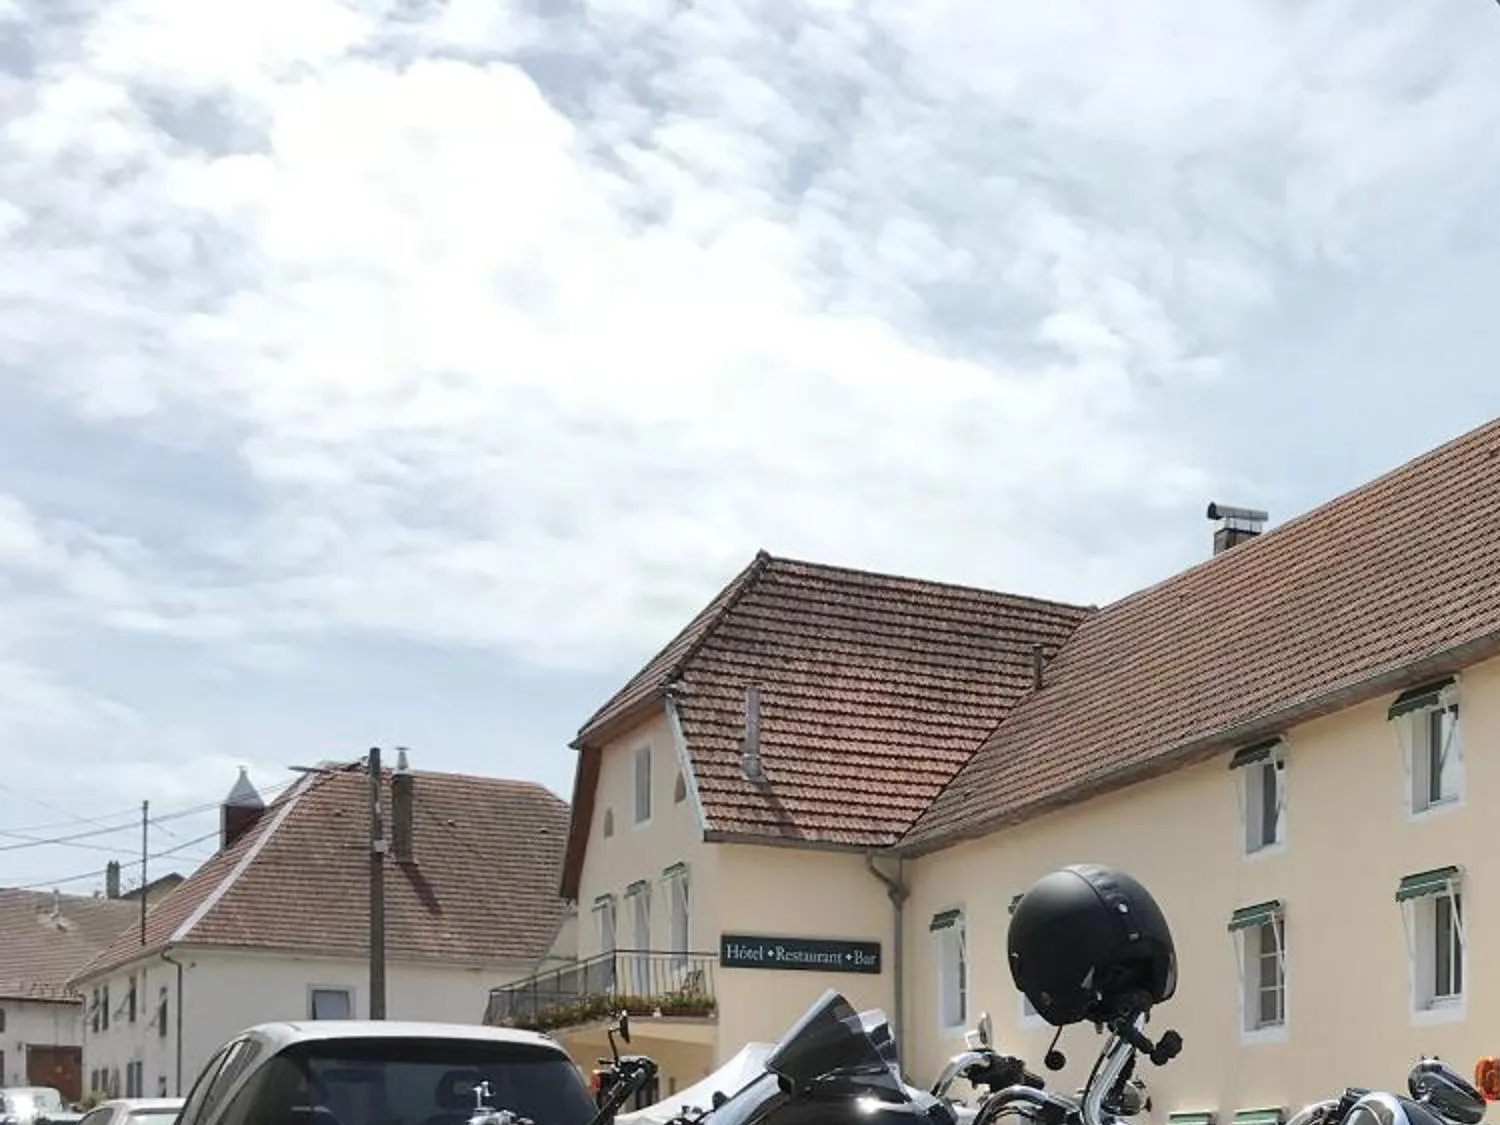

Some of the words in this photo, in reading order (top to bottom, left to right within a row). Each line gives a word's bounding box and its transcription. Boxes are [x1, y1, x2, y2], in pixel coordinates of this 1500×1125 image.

[727, 943, 764, 961] Hôtel
[775, 945, 842, 965] Restaurant
[853, 949, 877, 966] Bar
